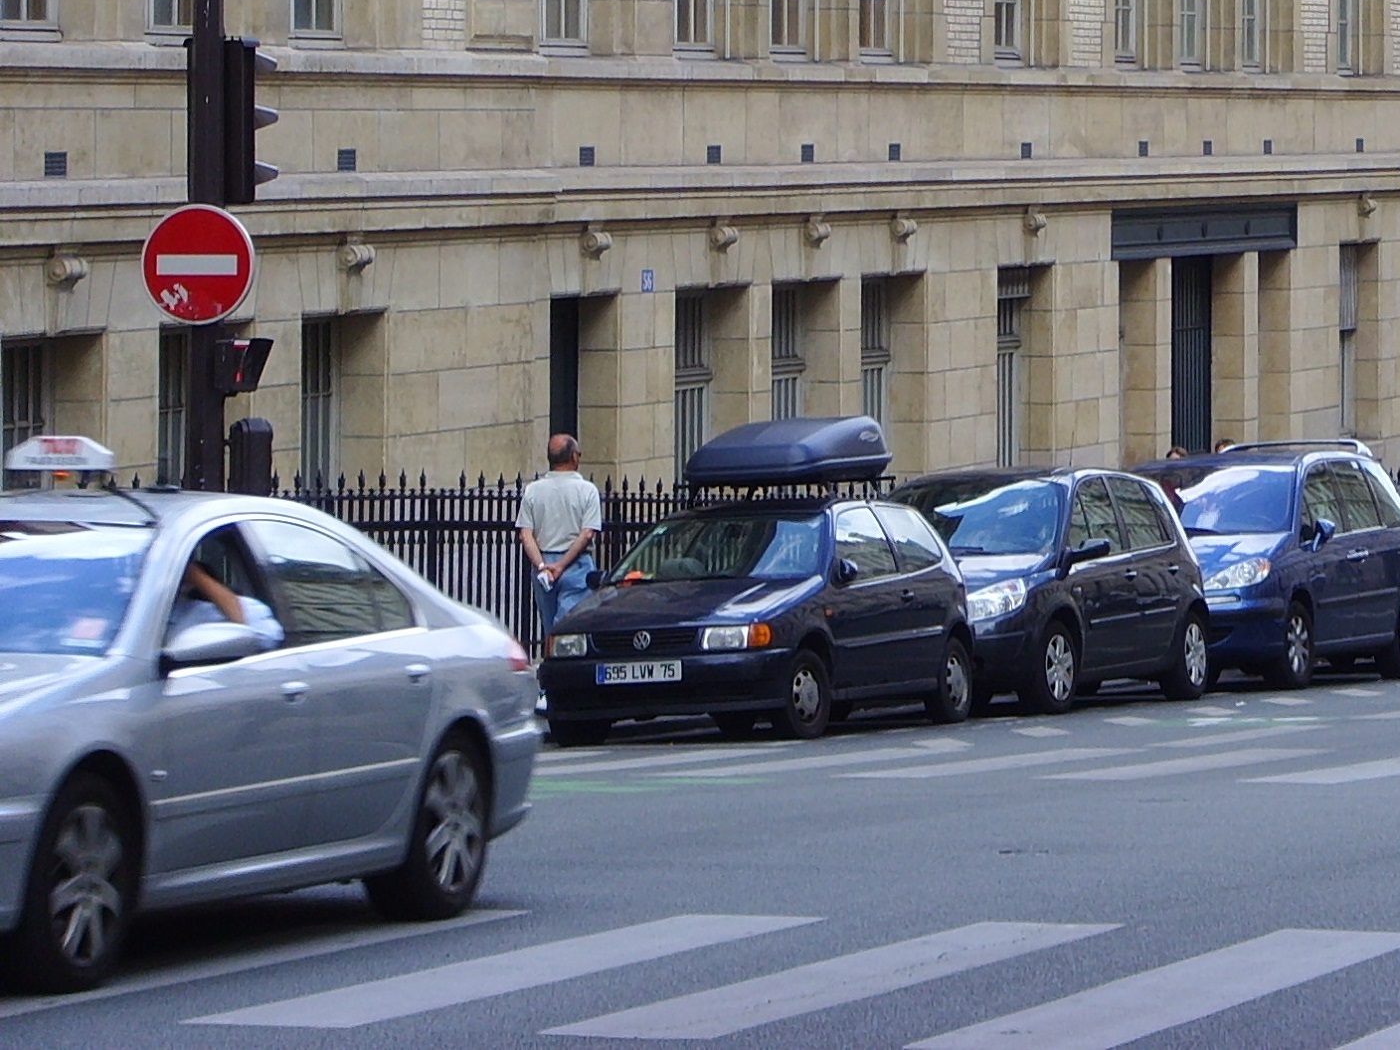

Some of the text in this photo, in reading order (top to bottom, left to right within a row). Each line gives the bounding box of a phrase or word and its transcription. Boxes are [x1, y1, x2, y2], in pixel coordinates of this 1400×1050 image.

[604, 663, 675, 680] 695 LVW 75
